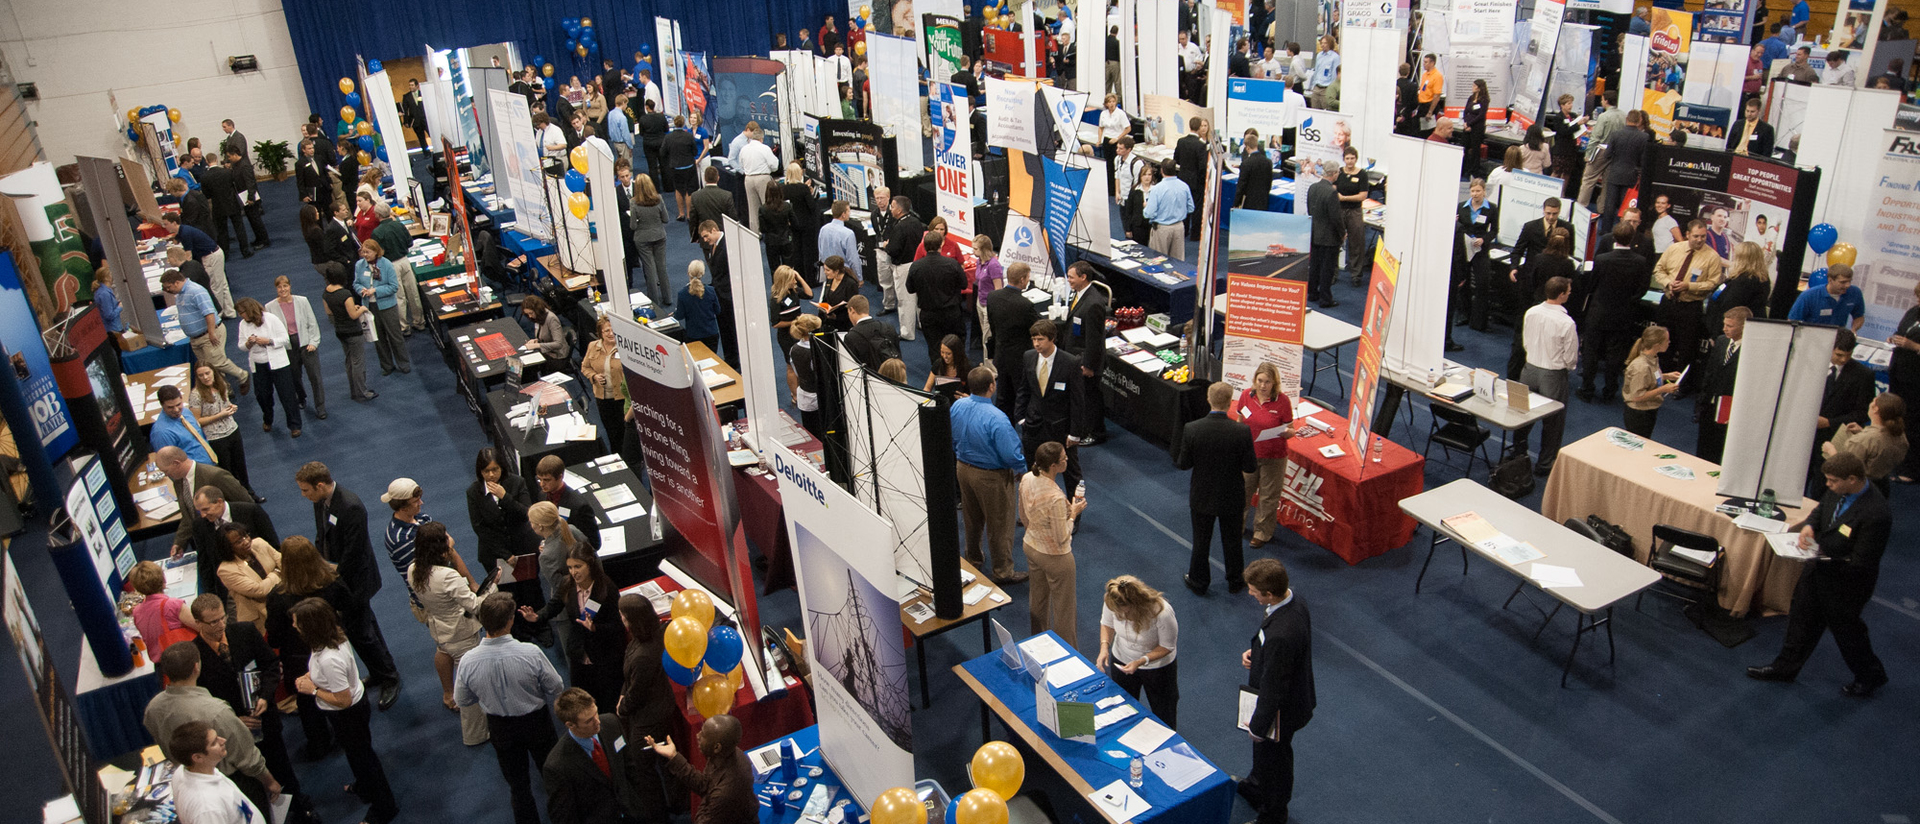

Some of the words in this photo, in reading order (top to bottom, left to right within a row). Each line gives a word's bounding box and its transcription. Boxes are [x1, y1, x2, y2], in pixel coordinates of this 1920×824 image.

[996, 95, 1024, 106] Recruiting
[832, 130, 855, 138] Investing
[1300, 124, 1321, 142] LSS
[936, 149, 966, 170] POWER
[937, 165, 968, 198] ONE
[1537, 181, 1559, 190] Systems
[1732, 173, 1750, 182] GREAT
[1751, 177, 1792, 193] OPPORTUNITIES
[1005, 248, 1044, 265] Schenck
[1864, 322, 1898, 332] astena
[613, 332, 661, 365] RAVELERS
[41, 411, 67, 436] CENTER
[631, 400, 666, 427] earching
[665, 414, 677, 431] for
[678, 425, 684, 436] a
[643, 423, 652, 437] is
[653, 430, 669, 446] one
[665, 454, 690, 480] toward
[692, 475, 698, 485] a
[647, 466, 666, 482] areer
[667, 474, 675, 488] is
[676, 482, 704, 507] another
[1283, 459, 1324, 505] EHL
[1294, 508, 1315, 531] Inc.
